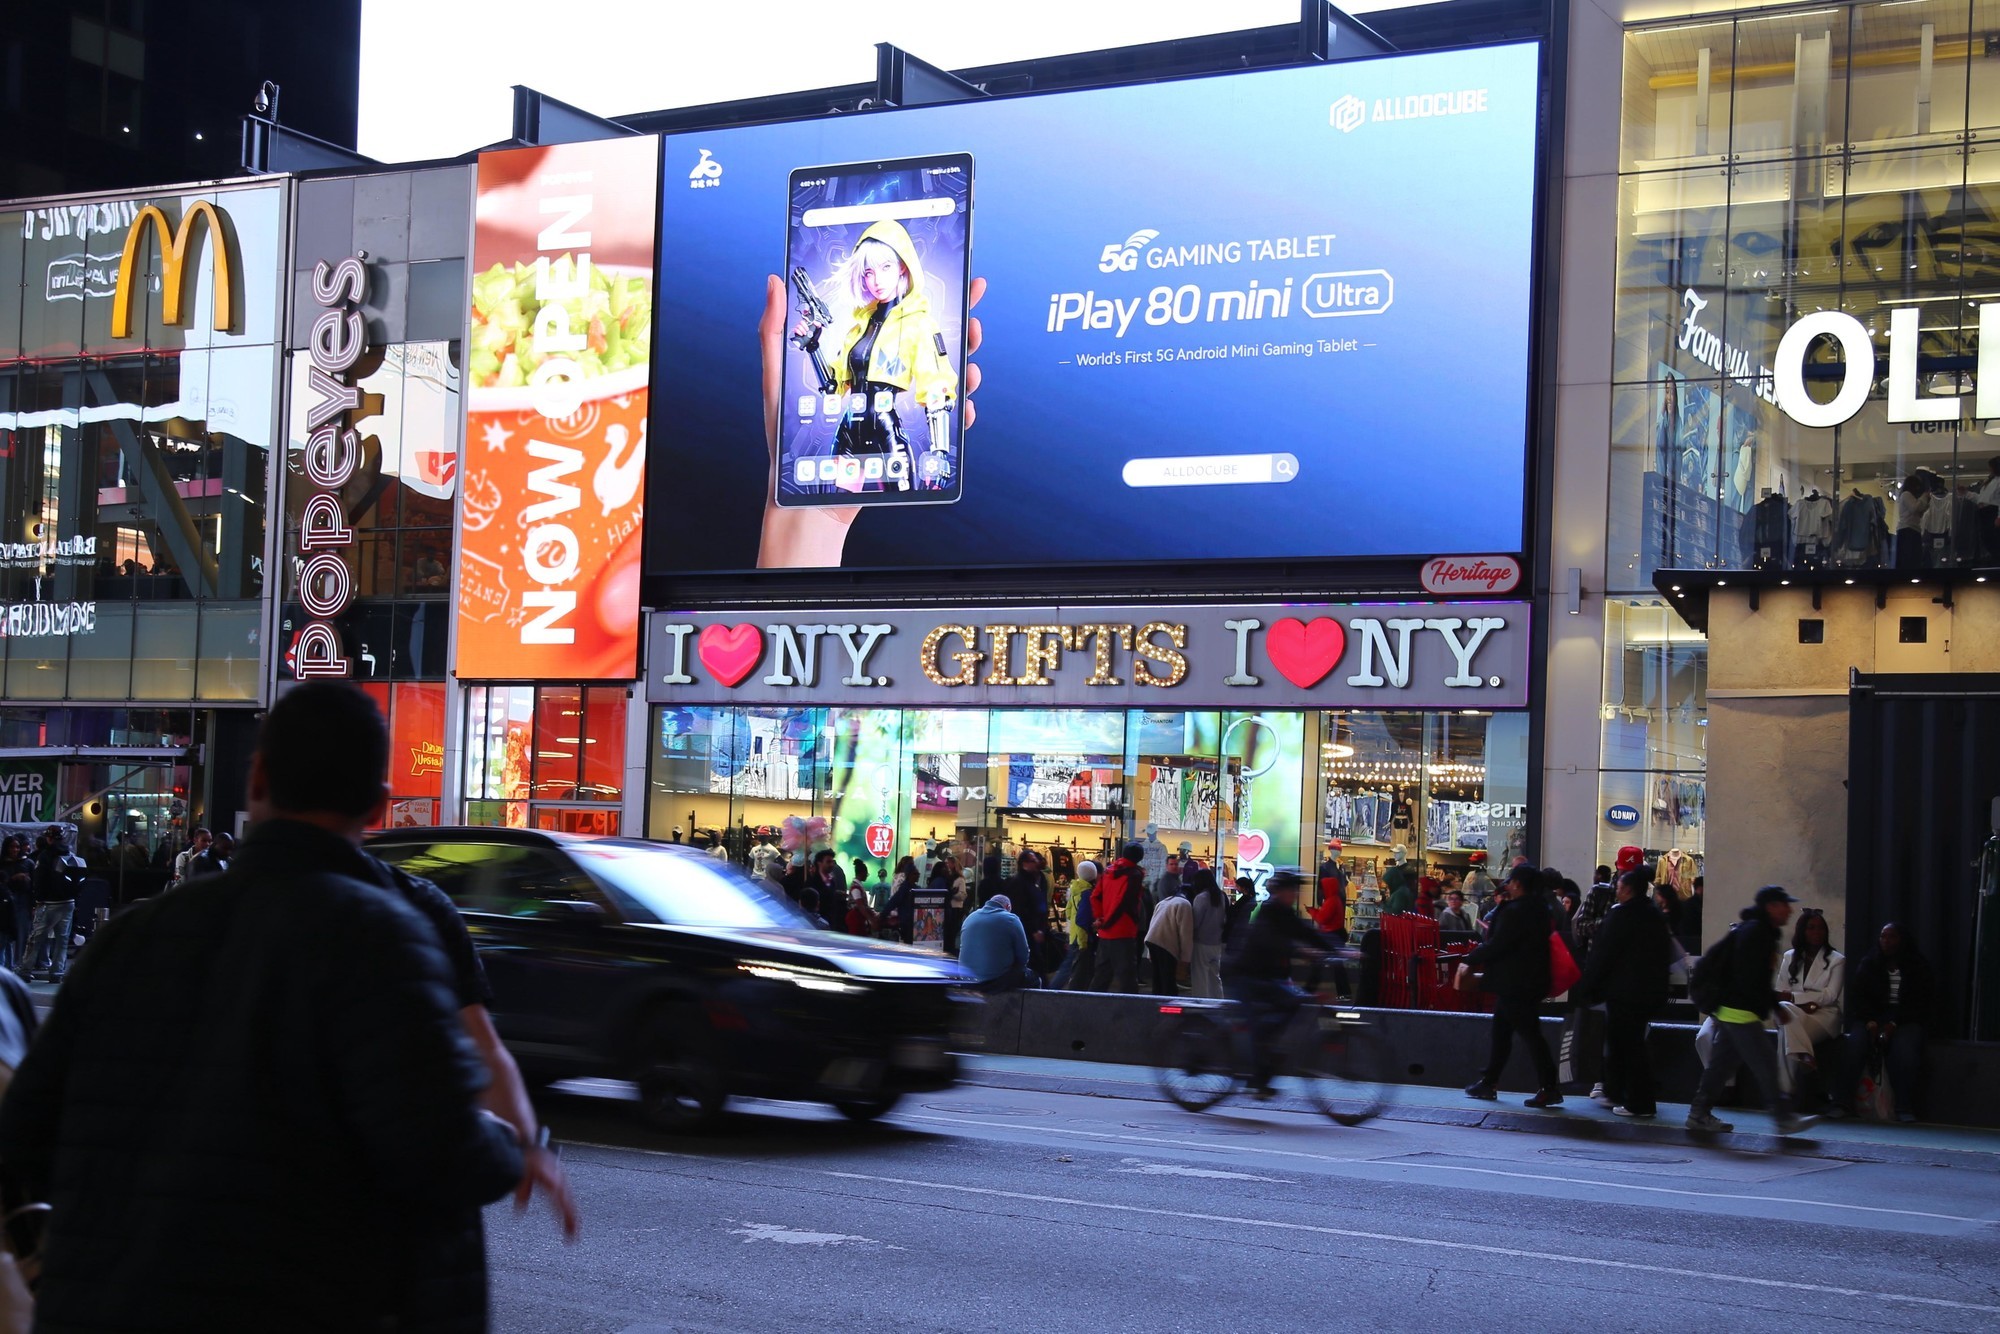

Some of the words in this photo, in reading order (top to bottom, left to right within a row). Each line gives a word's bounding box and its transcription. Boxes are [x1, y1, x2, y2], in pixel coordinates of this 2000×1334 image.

[1372, 88, 1488, 122] ALLDOCUBE
[1098, 240, 1139, 273] 5G
[1145, 243, 1241, 269] GAMING
[1246, 235, 1336, 261] TABLET
[531, 170, 594, 419] OPEN!
[1047, 290, 1142, 338] iPlay
[1145, 284, 1201, 326] 80
[1206, 277, 1294, 322] mini
[1316, 281, 1380, 308] Ultra
[1075, 351, 1122, 366] World's
[1125, 350, 1153, 364] First
[1156, 349, 1174, 362] 5G
[1176, 345, 1228, 361] Android
[1231, 343, 1259, 357] Mini
[1262, 341, 1314, 358] Gaming
[1317, 338, 1358, 353] Tablet
[1678, 288, 1751, 388] Famous
[1163, 464, 1238, 478] ALLDOCUBE
[520, 439, 583, 644] NOW
[1430, 560, 1512, 589] Heritage
[663, 623, 695, 685] I
[920, 623, 1189, 687] GIFTS
[1223, 619, 1261, 686] I
[1157, 767, 1176, 785] NY
[1611, 809, 1624, 820] OLD
[1624, 809, 1637, 821] NAVY
[872, 840, 890, 852] NY
